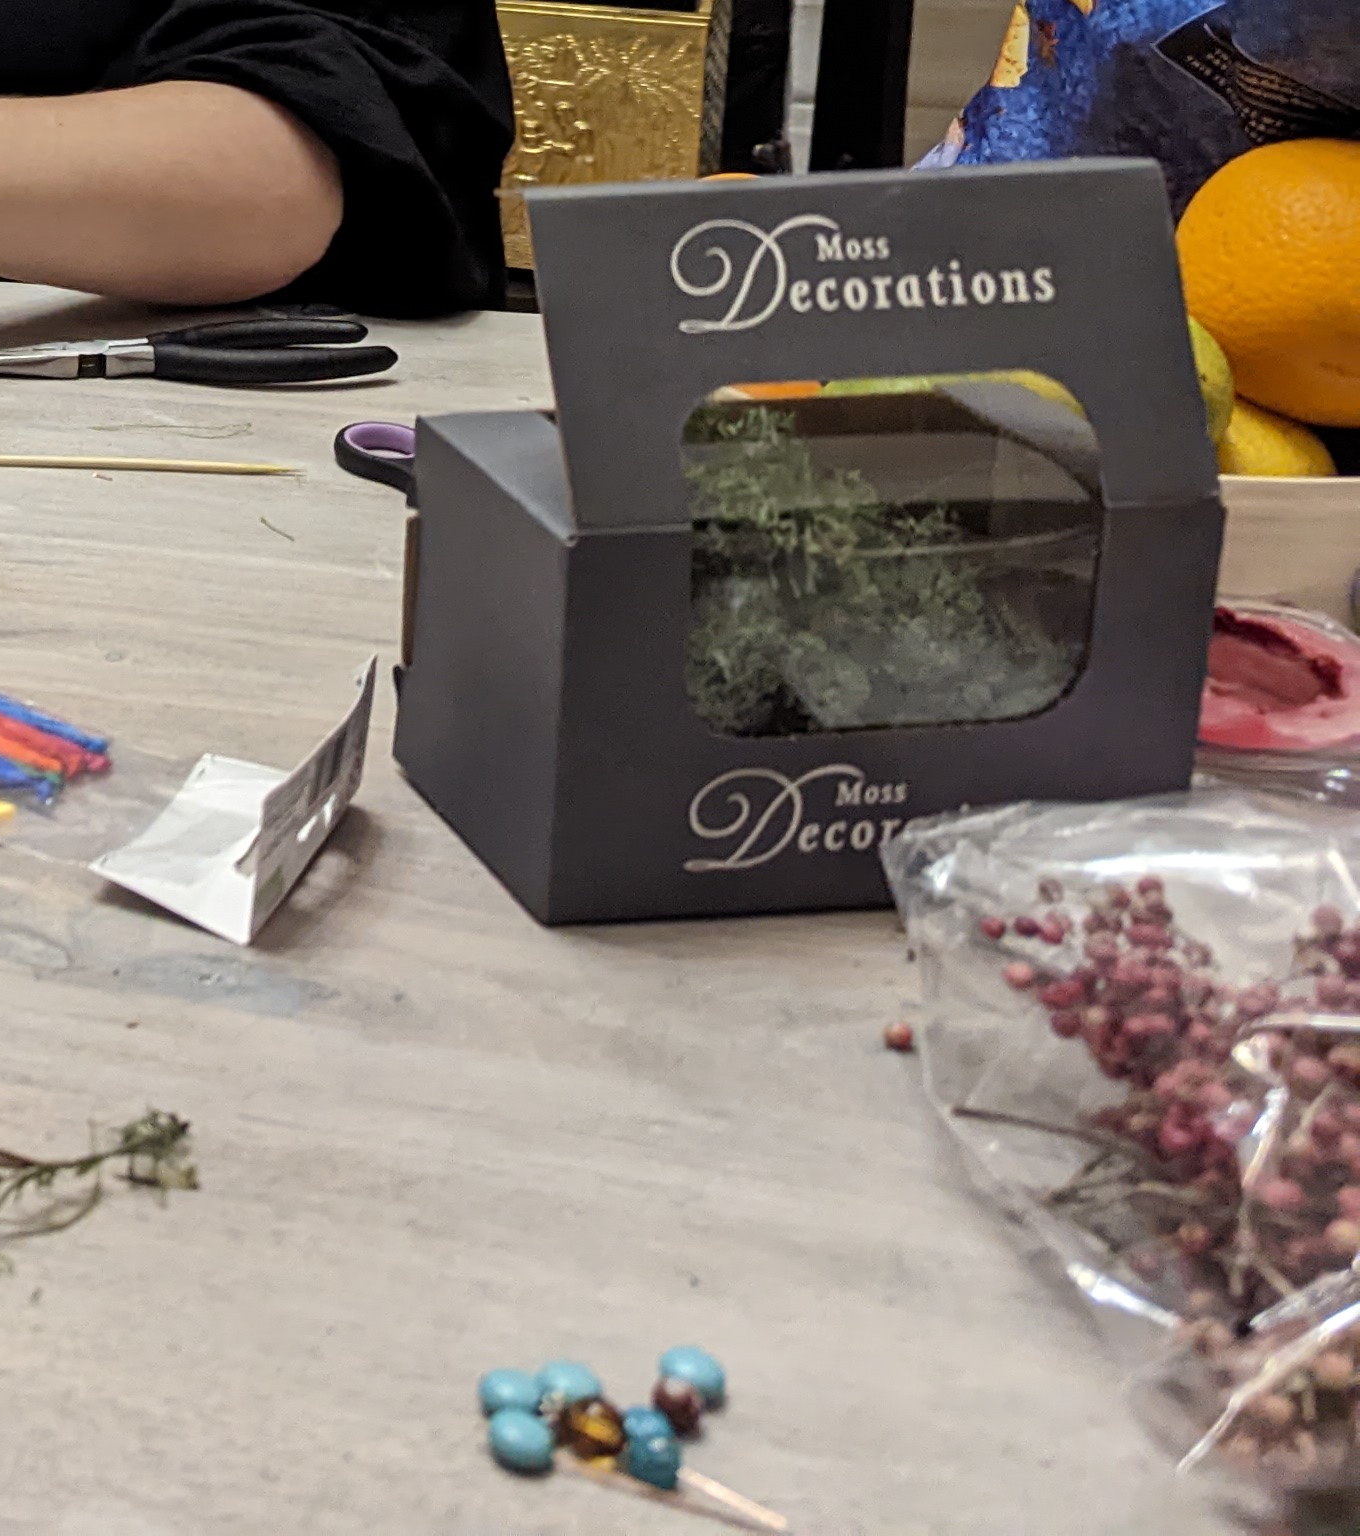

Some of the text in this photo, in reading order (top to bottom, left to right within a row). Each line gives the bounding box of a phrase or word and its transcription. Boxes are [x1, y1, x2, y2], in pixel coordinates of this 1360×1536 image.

[815, 231, 890, 262] Moss
[670, 214, 1057, 335] Decorations
[835, 780, 908, 807] Moss
